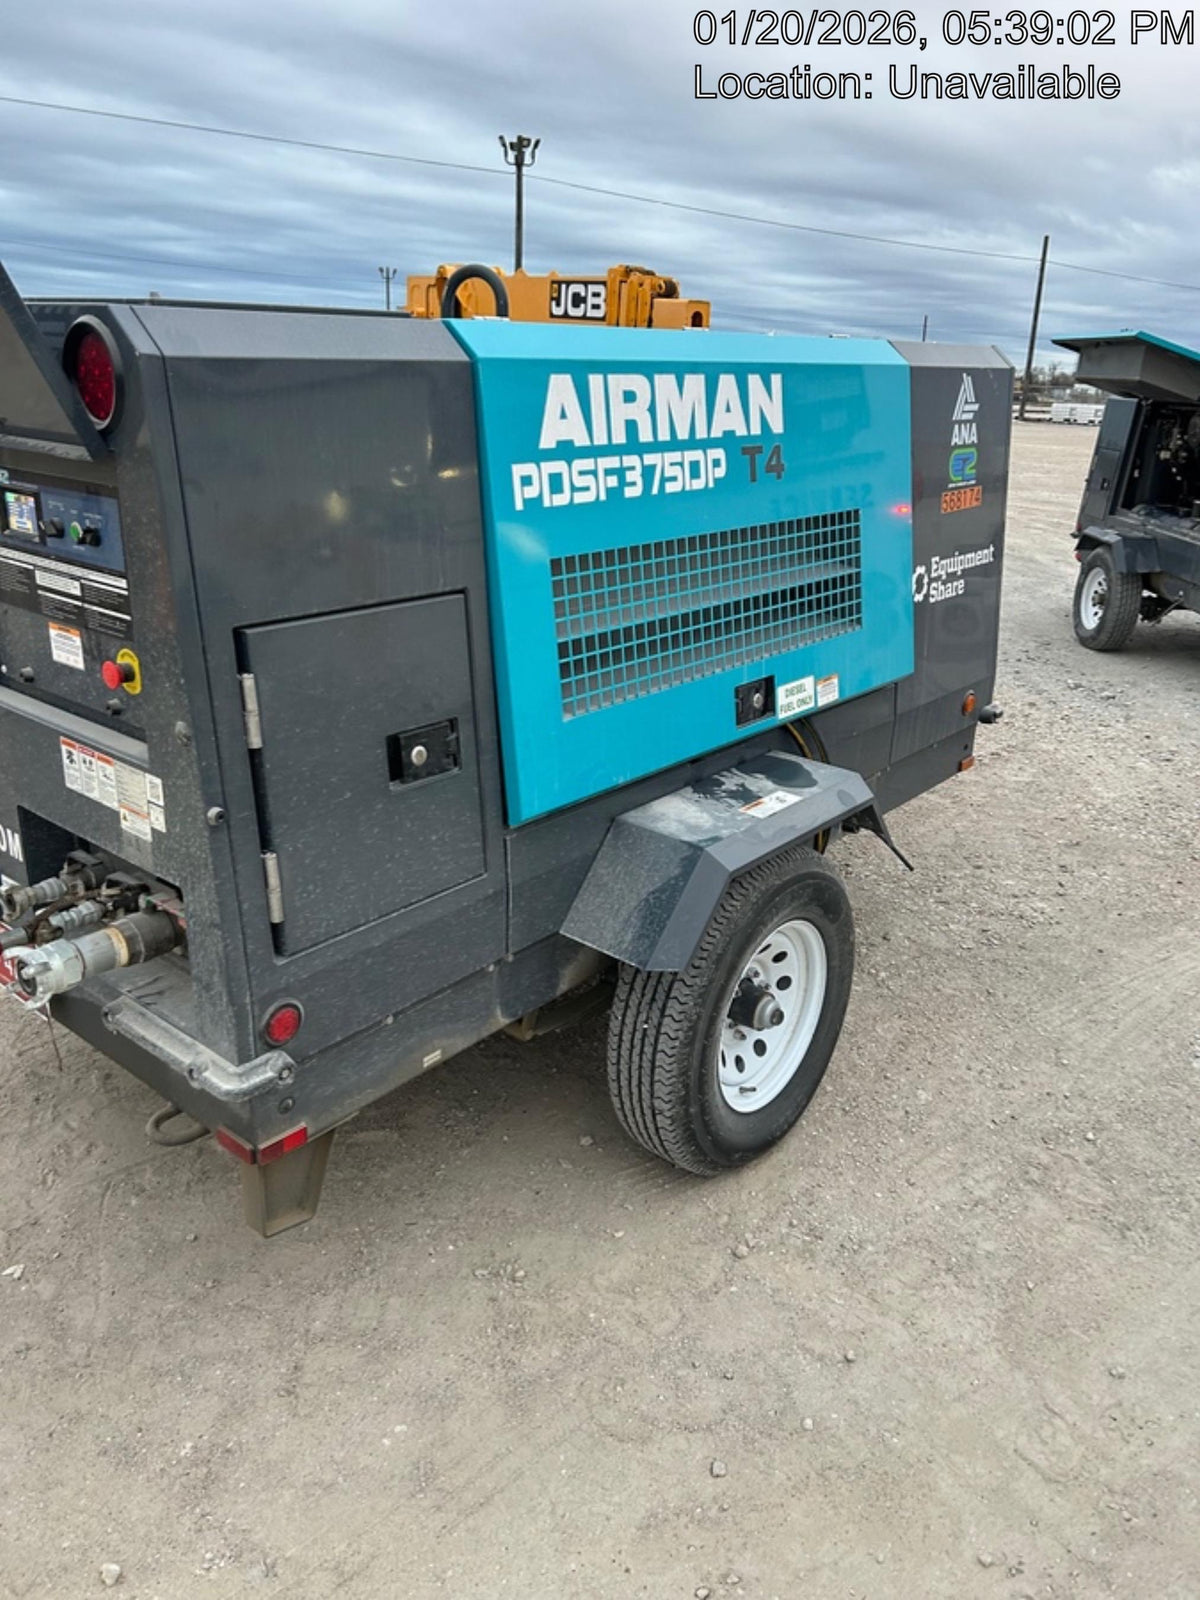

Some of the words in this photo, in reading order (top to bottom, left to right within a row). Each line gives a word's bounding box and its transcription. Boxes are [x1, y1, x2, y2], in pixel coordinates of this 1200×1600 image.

[551, 283, 606, 317] JCB
[538, 373, 784, 449] AIRMAN
[951, 423, 978, 446] ANA
[511, 448, 727, 511] PDSF375DP
[741, 444, 786, 483] T4
[930, 543, 995, 580] Equipment
[929, 579, 965, 603] Share
